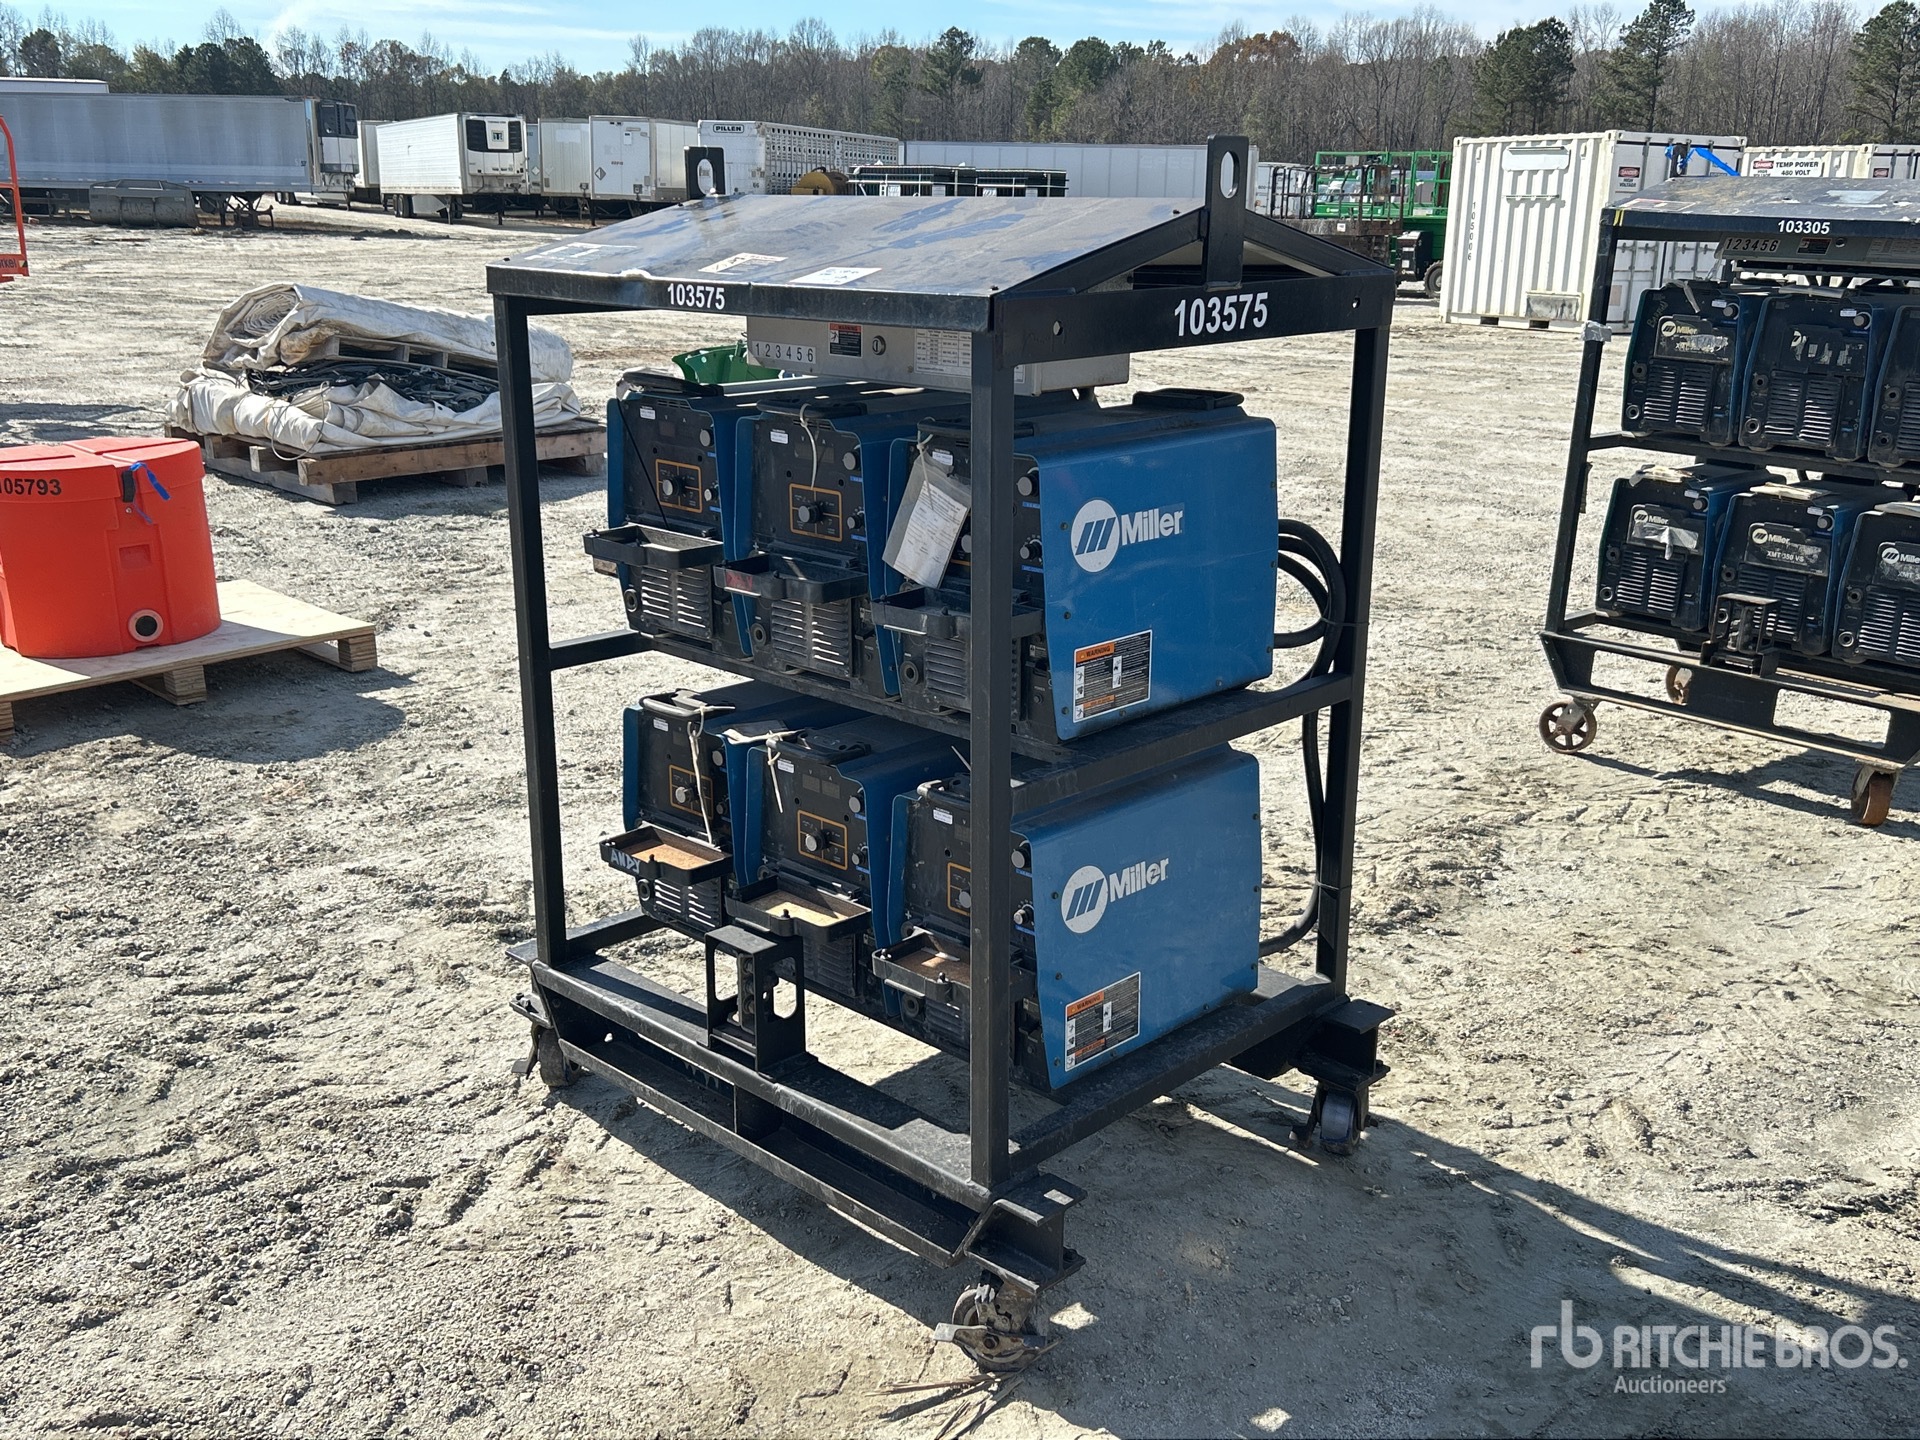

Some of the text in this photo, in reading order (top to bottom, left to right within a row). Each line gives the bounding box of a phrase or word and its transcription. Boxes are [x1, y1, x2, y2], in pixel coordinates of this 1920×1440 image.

[1778, 220, 1830, 235] 103305
[1726, 238, 1779, 252] 123456
[667, 282, 725, 310] 103575
[1174, 292, 1268, 336] 103575
[1676, 326, 1698, 334] Miller
[1121, 508, 1183, 546] Miller
[1648, 515, 1668, 524] Miller
[1768, 534, 1790, 544] Miller
[1086, 646, 1110, 656] WARNING
[610, 848, 640, 874] ANDY
[1109, 858, 1169, 902] Miller
